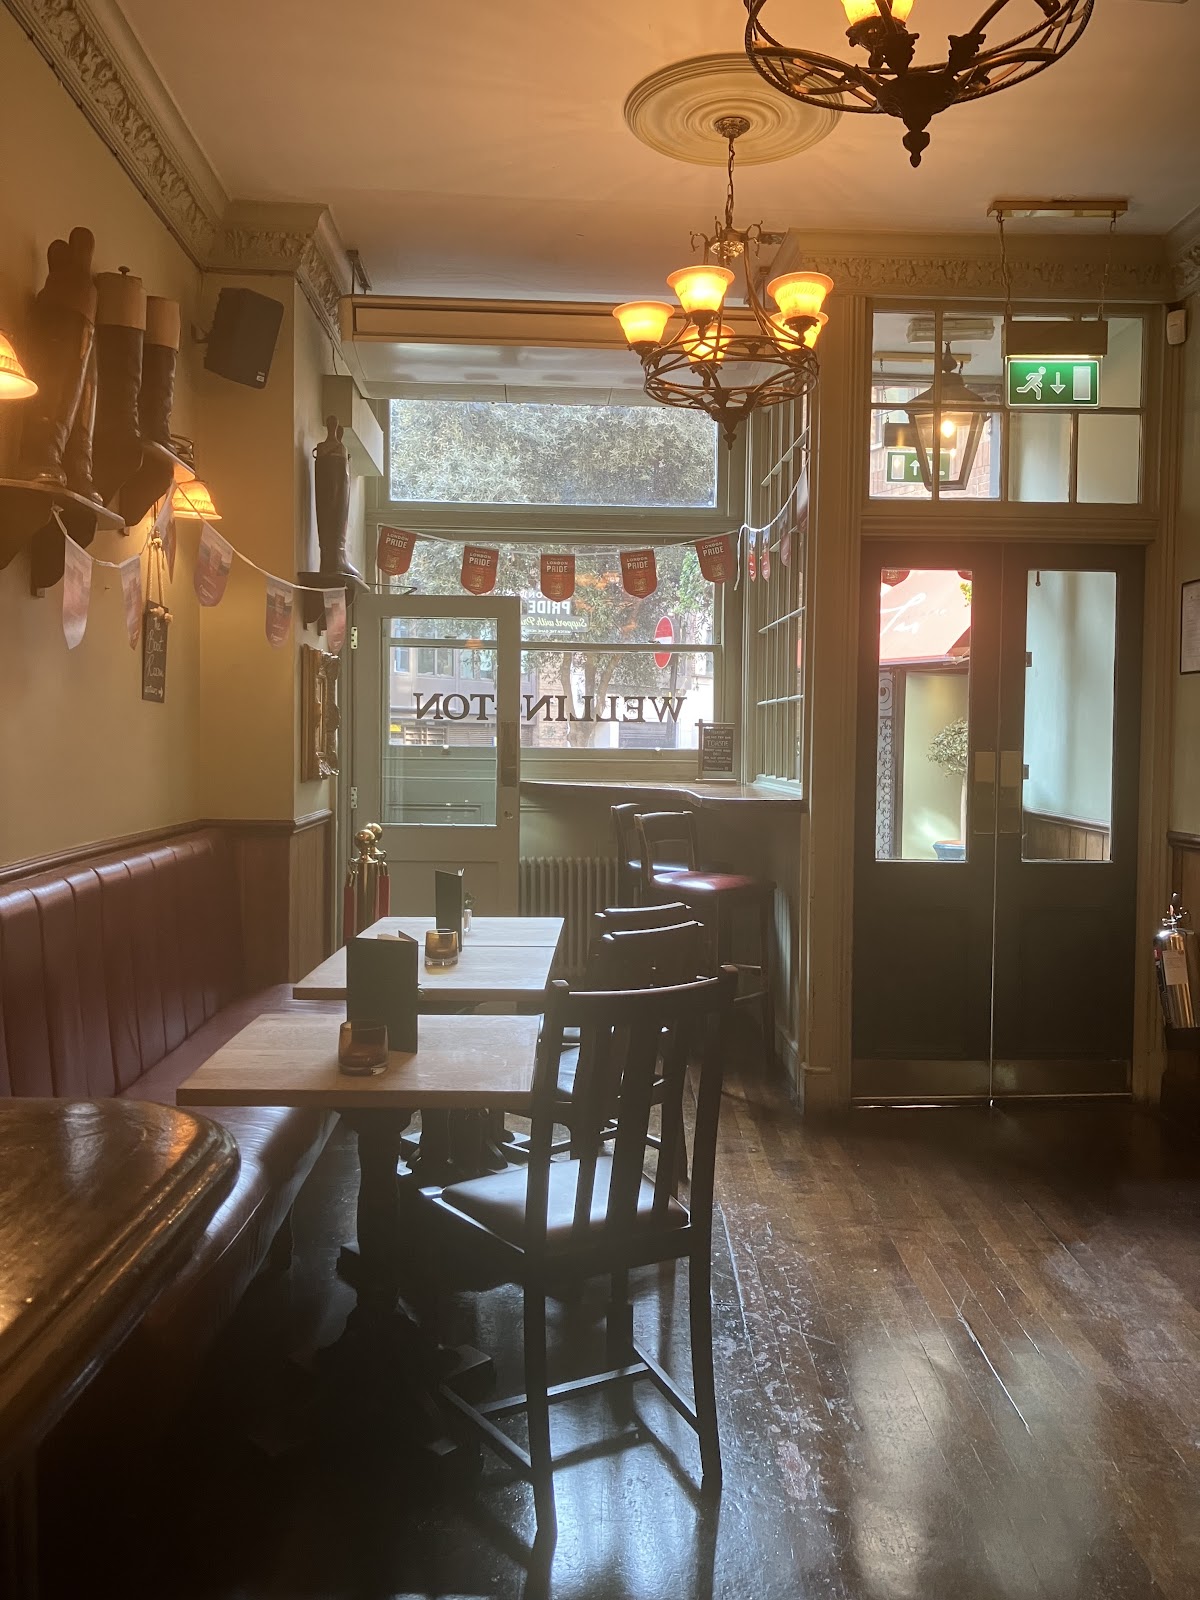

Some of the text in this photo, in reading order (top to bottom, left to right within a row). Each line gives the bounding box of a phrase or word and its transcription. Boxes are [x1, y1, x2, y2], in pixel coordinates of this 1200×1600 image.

[387, 533, 409, 541] LONDON
[385, 537, 408, 549] PRIDE
[702, 541, 723, 549] LONDON
[703, 546, 724, 557] PRIDE
[468, 557, 491, 567] PRIDE
[627, 561, 649, 569] PRIDE
[546, 565, 568, 573] PRIDE
